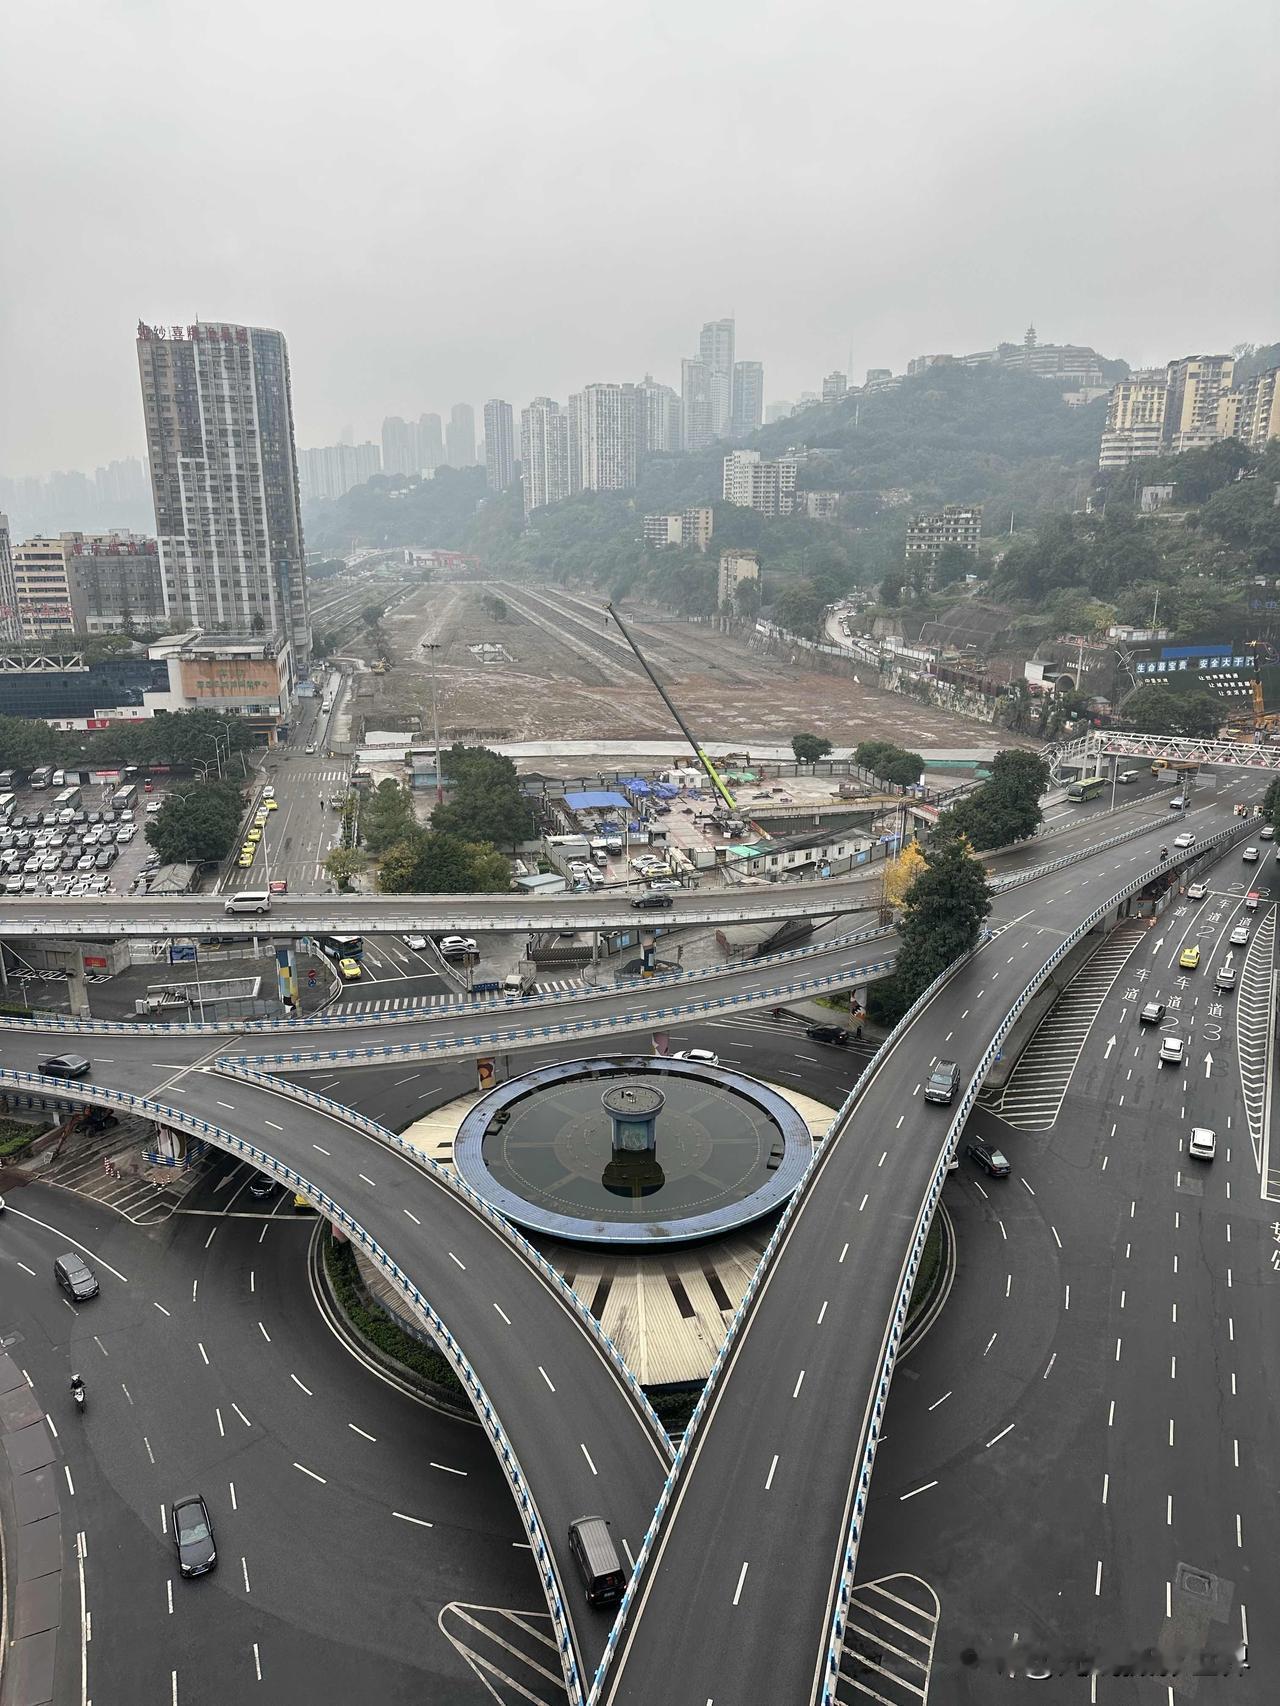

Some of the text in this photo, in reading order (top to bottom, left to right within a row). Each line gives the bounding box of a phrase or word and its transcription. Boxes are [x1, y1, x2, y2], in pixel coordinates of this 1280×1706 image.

[1137, 659, 1187, 673] 生命最宝贵
[1227, 882, 1245, 893] 2
